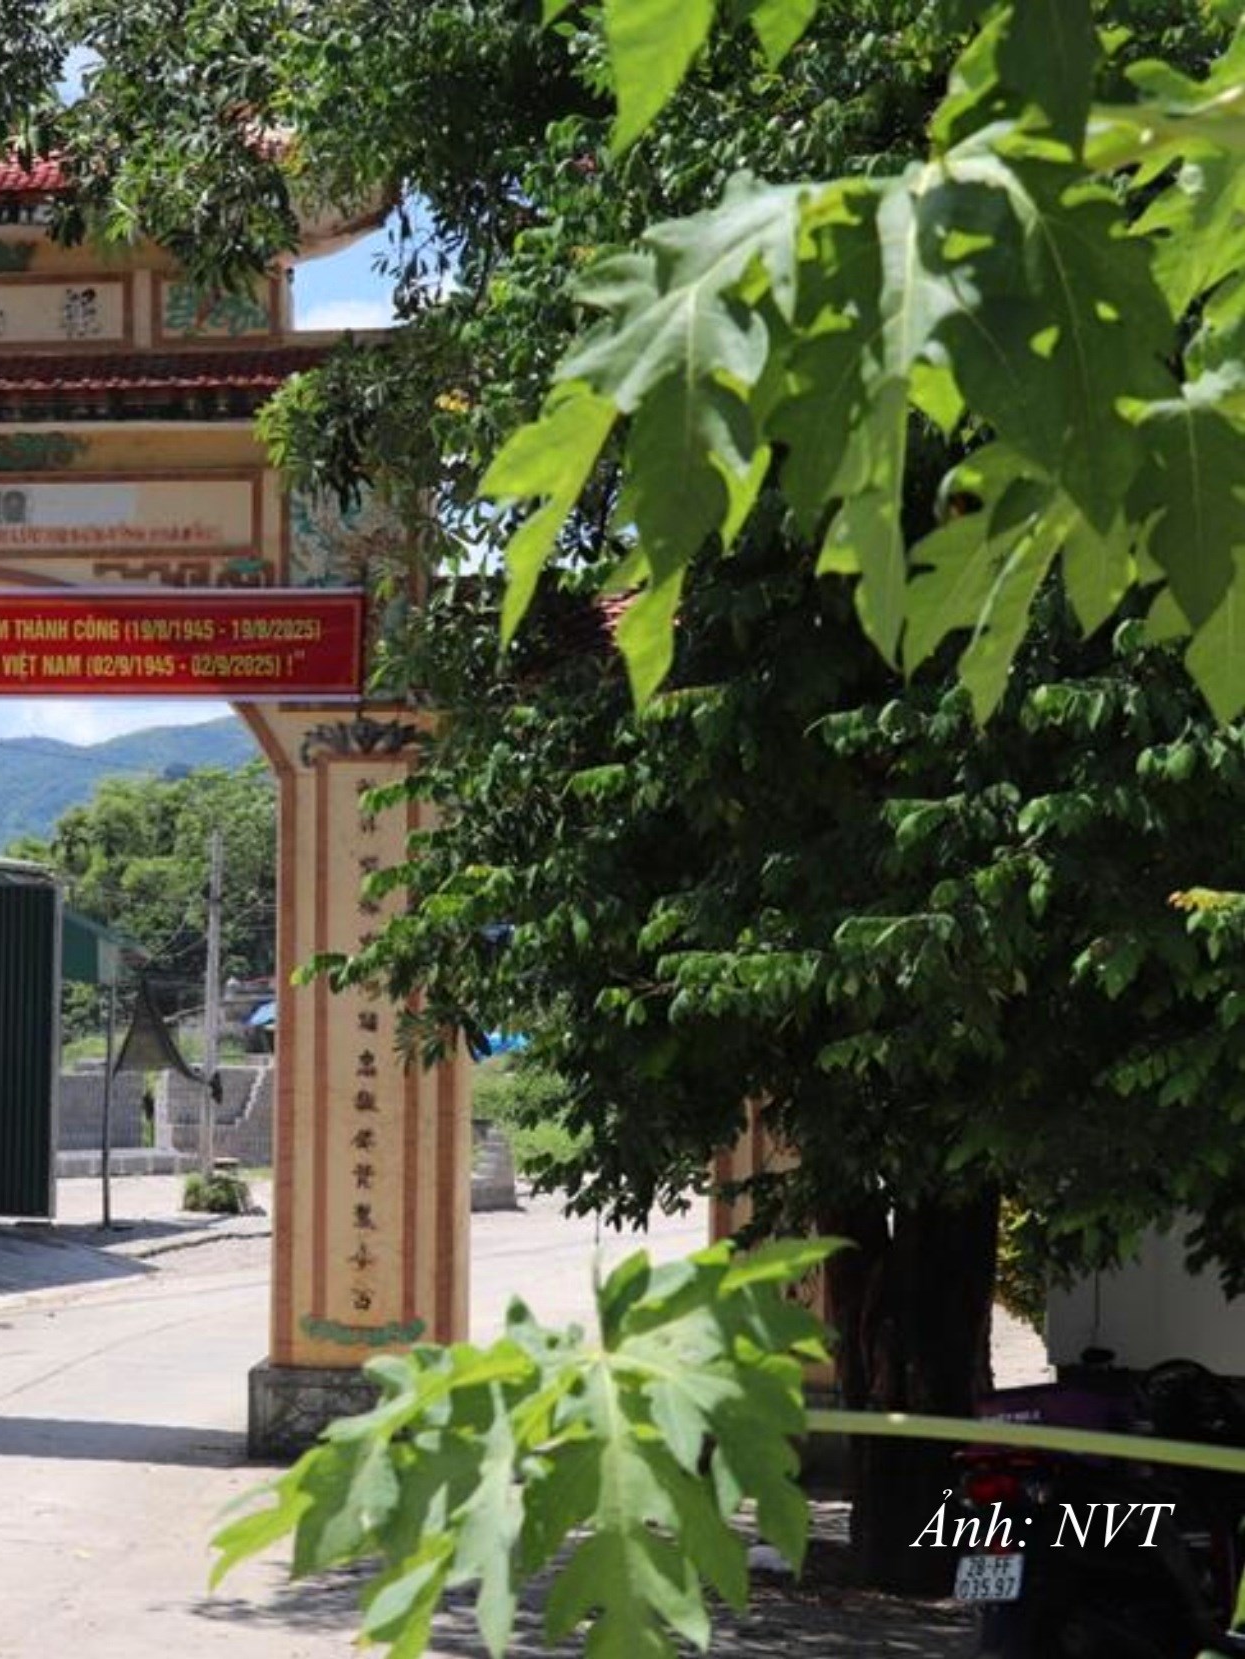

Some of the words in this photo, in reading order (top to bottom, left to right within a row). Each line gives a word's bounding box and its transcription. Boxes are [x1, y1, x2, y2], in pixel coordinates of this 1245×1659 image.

[13, 615, 69, 641] THÀNH
[73, 614, 120, 641] CÔNG
[2, 649, 39, 681] VIỆT
[42, 654, 82, 677] NAM
